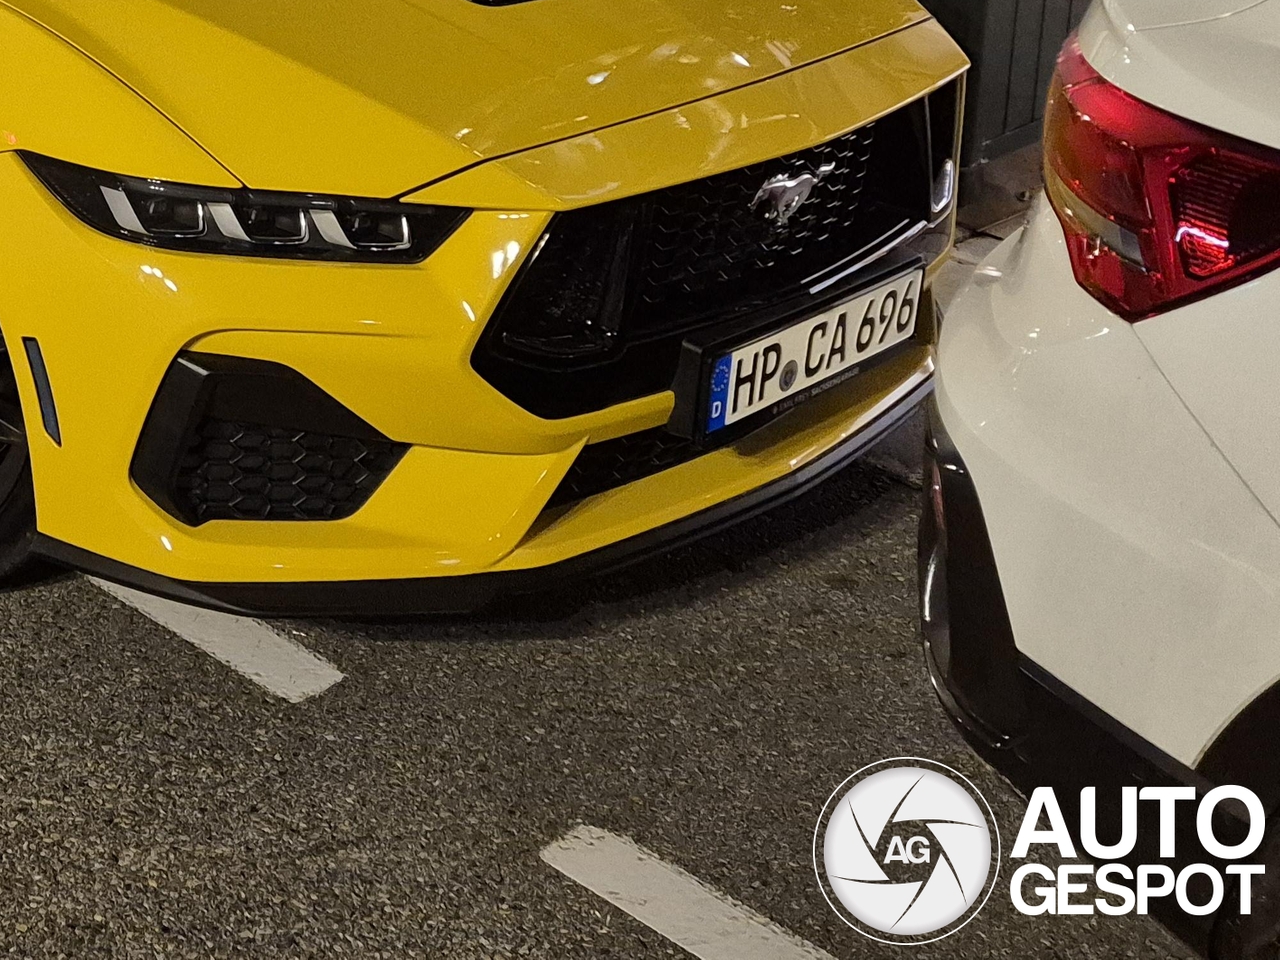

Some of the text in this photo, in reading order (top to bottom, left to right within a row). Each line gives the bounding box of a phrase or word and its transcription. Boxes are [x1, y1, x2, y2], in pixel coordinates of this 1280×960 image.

[731, 279, 914, 415] HP CA 696
[711, 400, 722, 419] D
